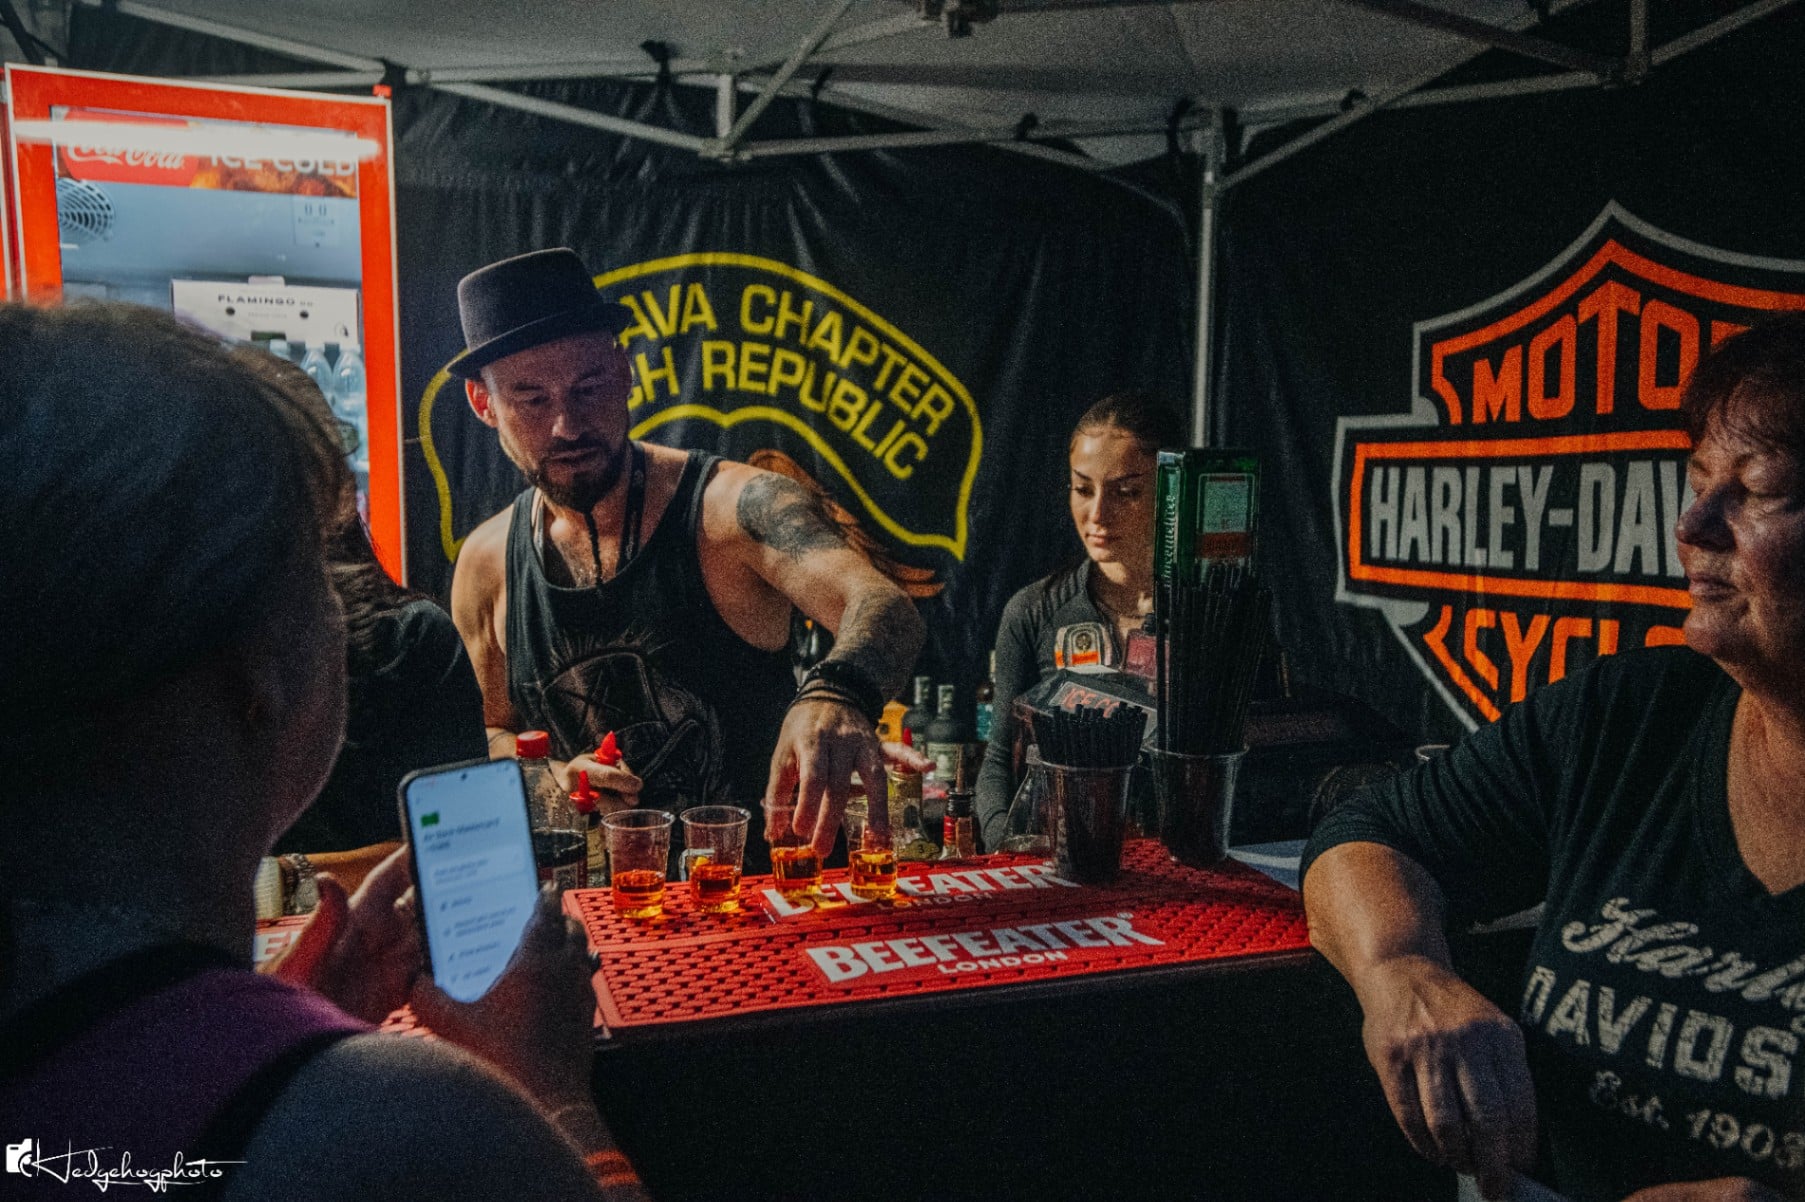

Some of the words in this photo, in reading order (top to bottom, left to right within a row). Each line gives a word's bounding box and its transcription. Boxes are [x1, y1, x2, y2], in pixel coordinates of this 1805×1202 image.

[619, 282, 718, 349] AVA
[740, 283, 955, 437] CHAPTER
[1472, 280, 1753, 424] MOTO
[702, 340, 929, 480] REPUBLIC
[761, 863, 1082, 917] BEEATER
[806, 917, 1165, 983] BEEFEATER
[937, 950, 1068, 975] LONDON
